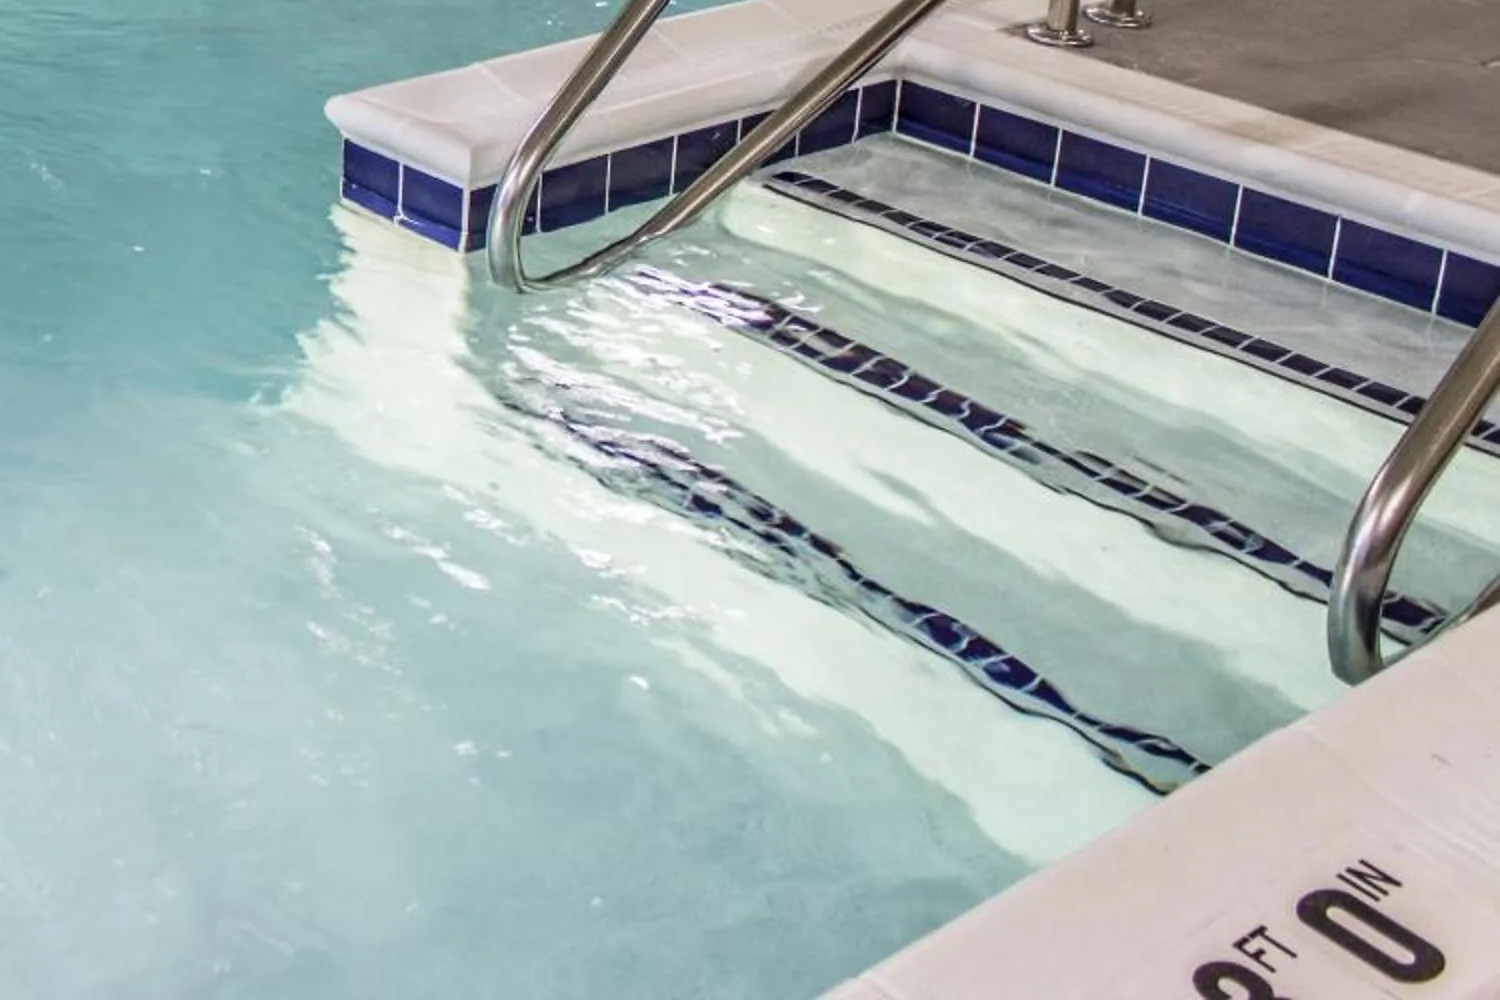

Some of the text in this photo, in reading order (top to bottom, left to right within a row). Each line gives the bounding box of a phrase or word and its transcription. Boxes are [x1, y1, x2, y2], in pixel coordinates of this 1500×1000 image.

[1336, 858, 1403, 902] IN
[1232, 925, 1298, 973] FT
[1296, 889, 1446, 984] 0
